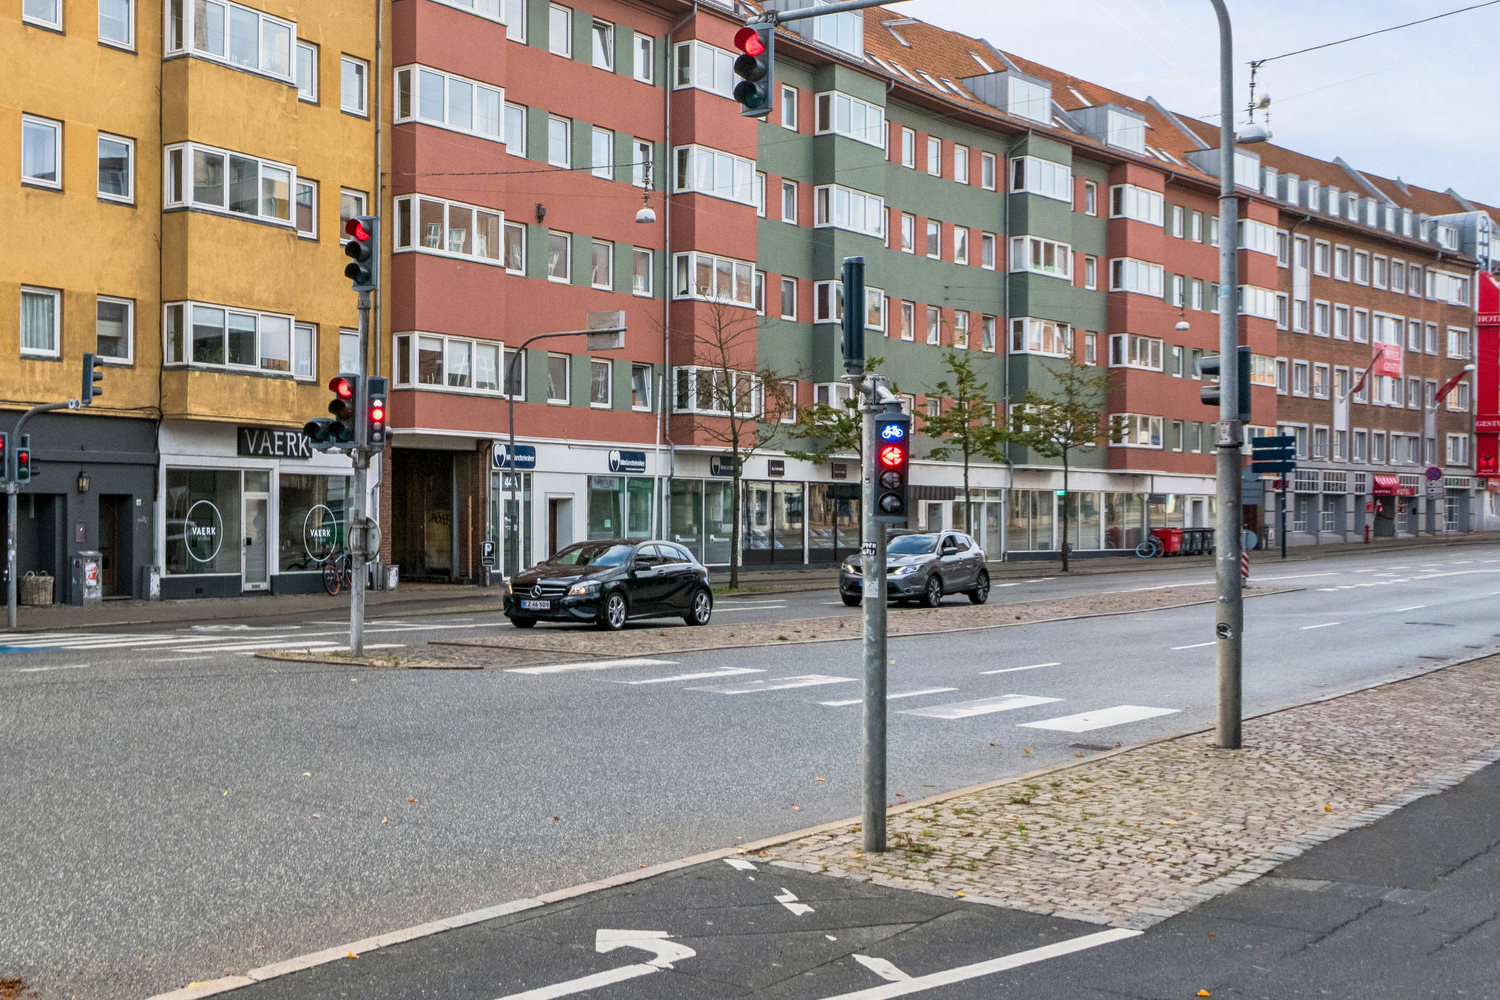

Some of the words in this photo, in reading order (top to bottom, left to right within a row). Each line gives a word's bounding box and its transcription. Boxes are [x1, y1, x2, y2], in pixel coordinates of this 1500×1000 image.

[244, 429, 310, 457] VAERK
[192, 526, 216, 536] VAERK
[310, 528, 331, 537] VAERK
[484, 543, 493, 557] P
